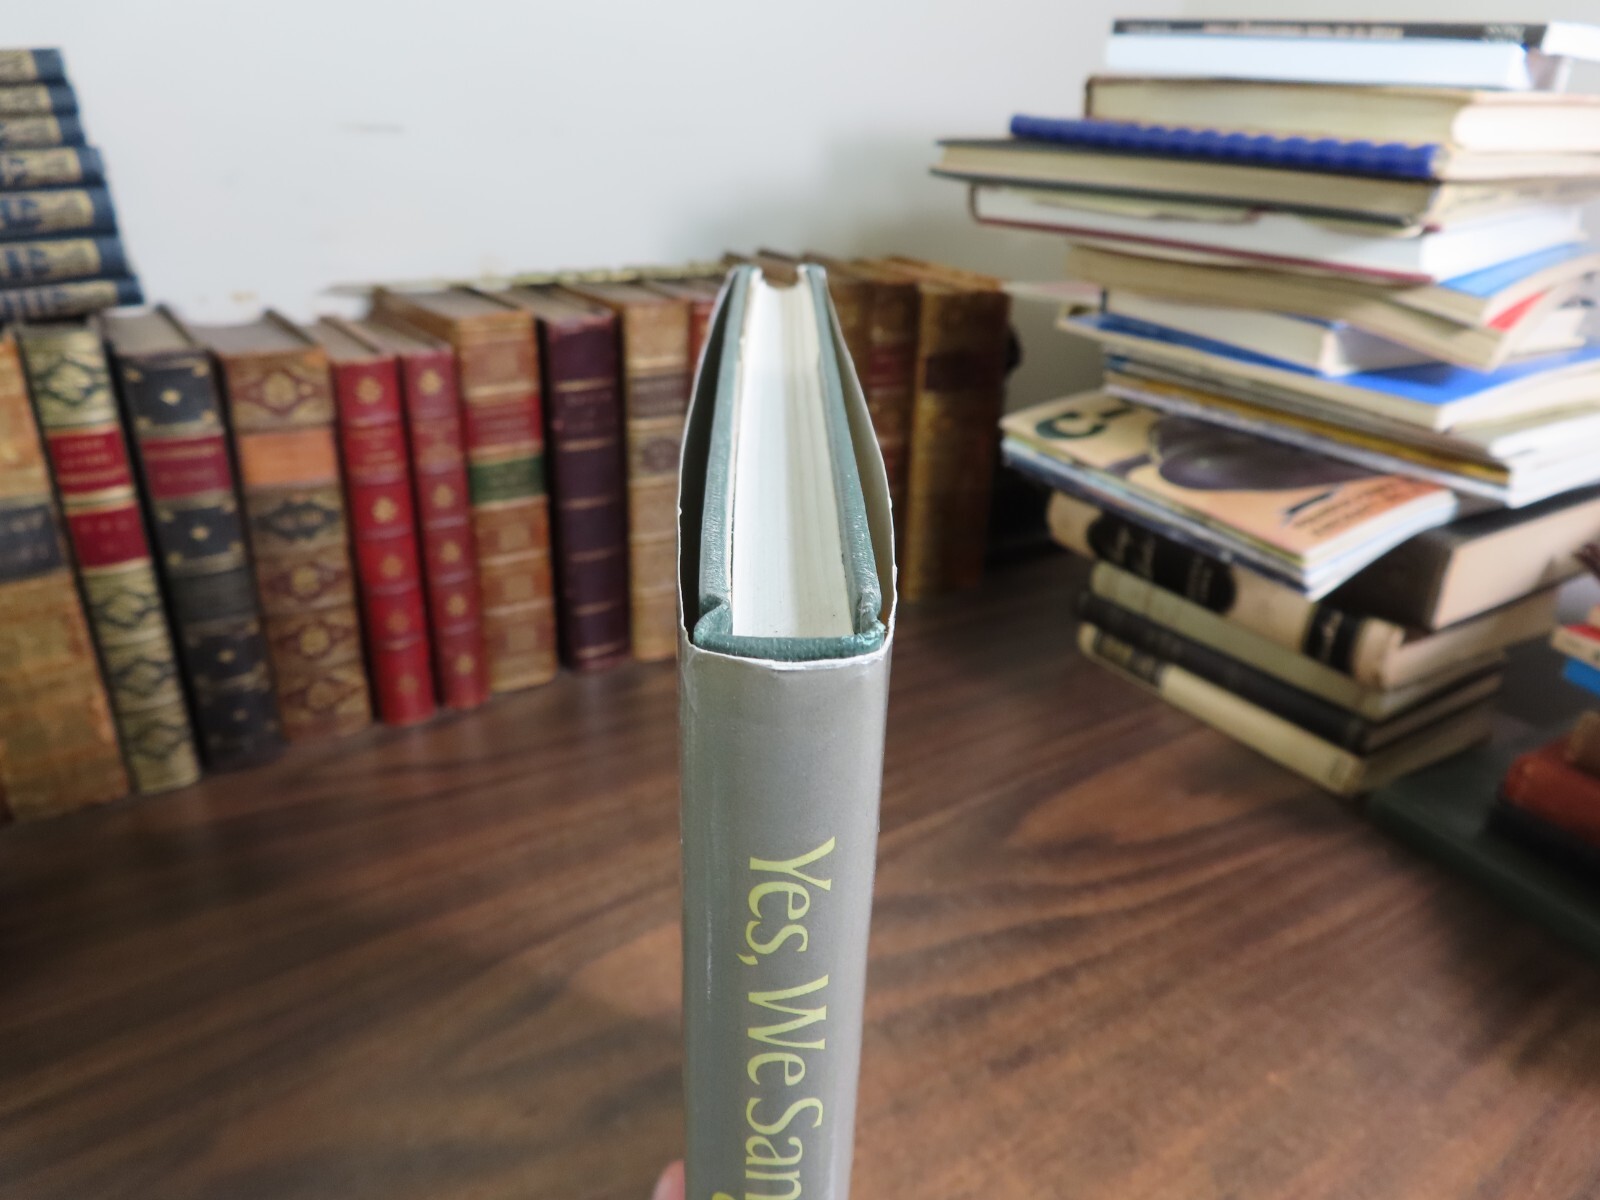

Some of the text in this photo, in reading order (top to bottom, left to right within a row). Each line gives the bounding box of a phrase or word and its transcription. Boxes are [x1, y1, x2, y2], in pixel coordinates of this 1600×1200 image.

[711, 836, 836, 1200] Yes, We San
